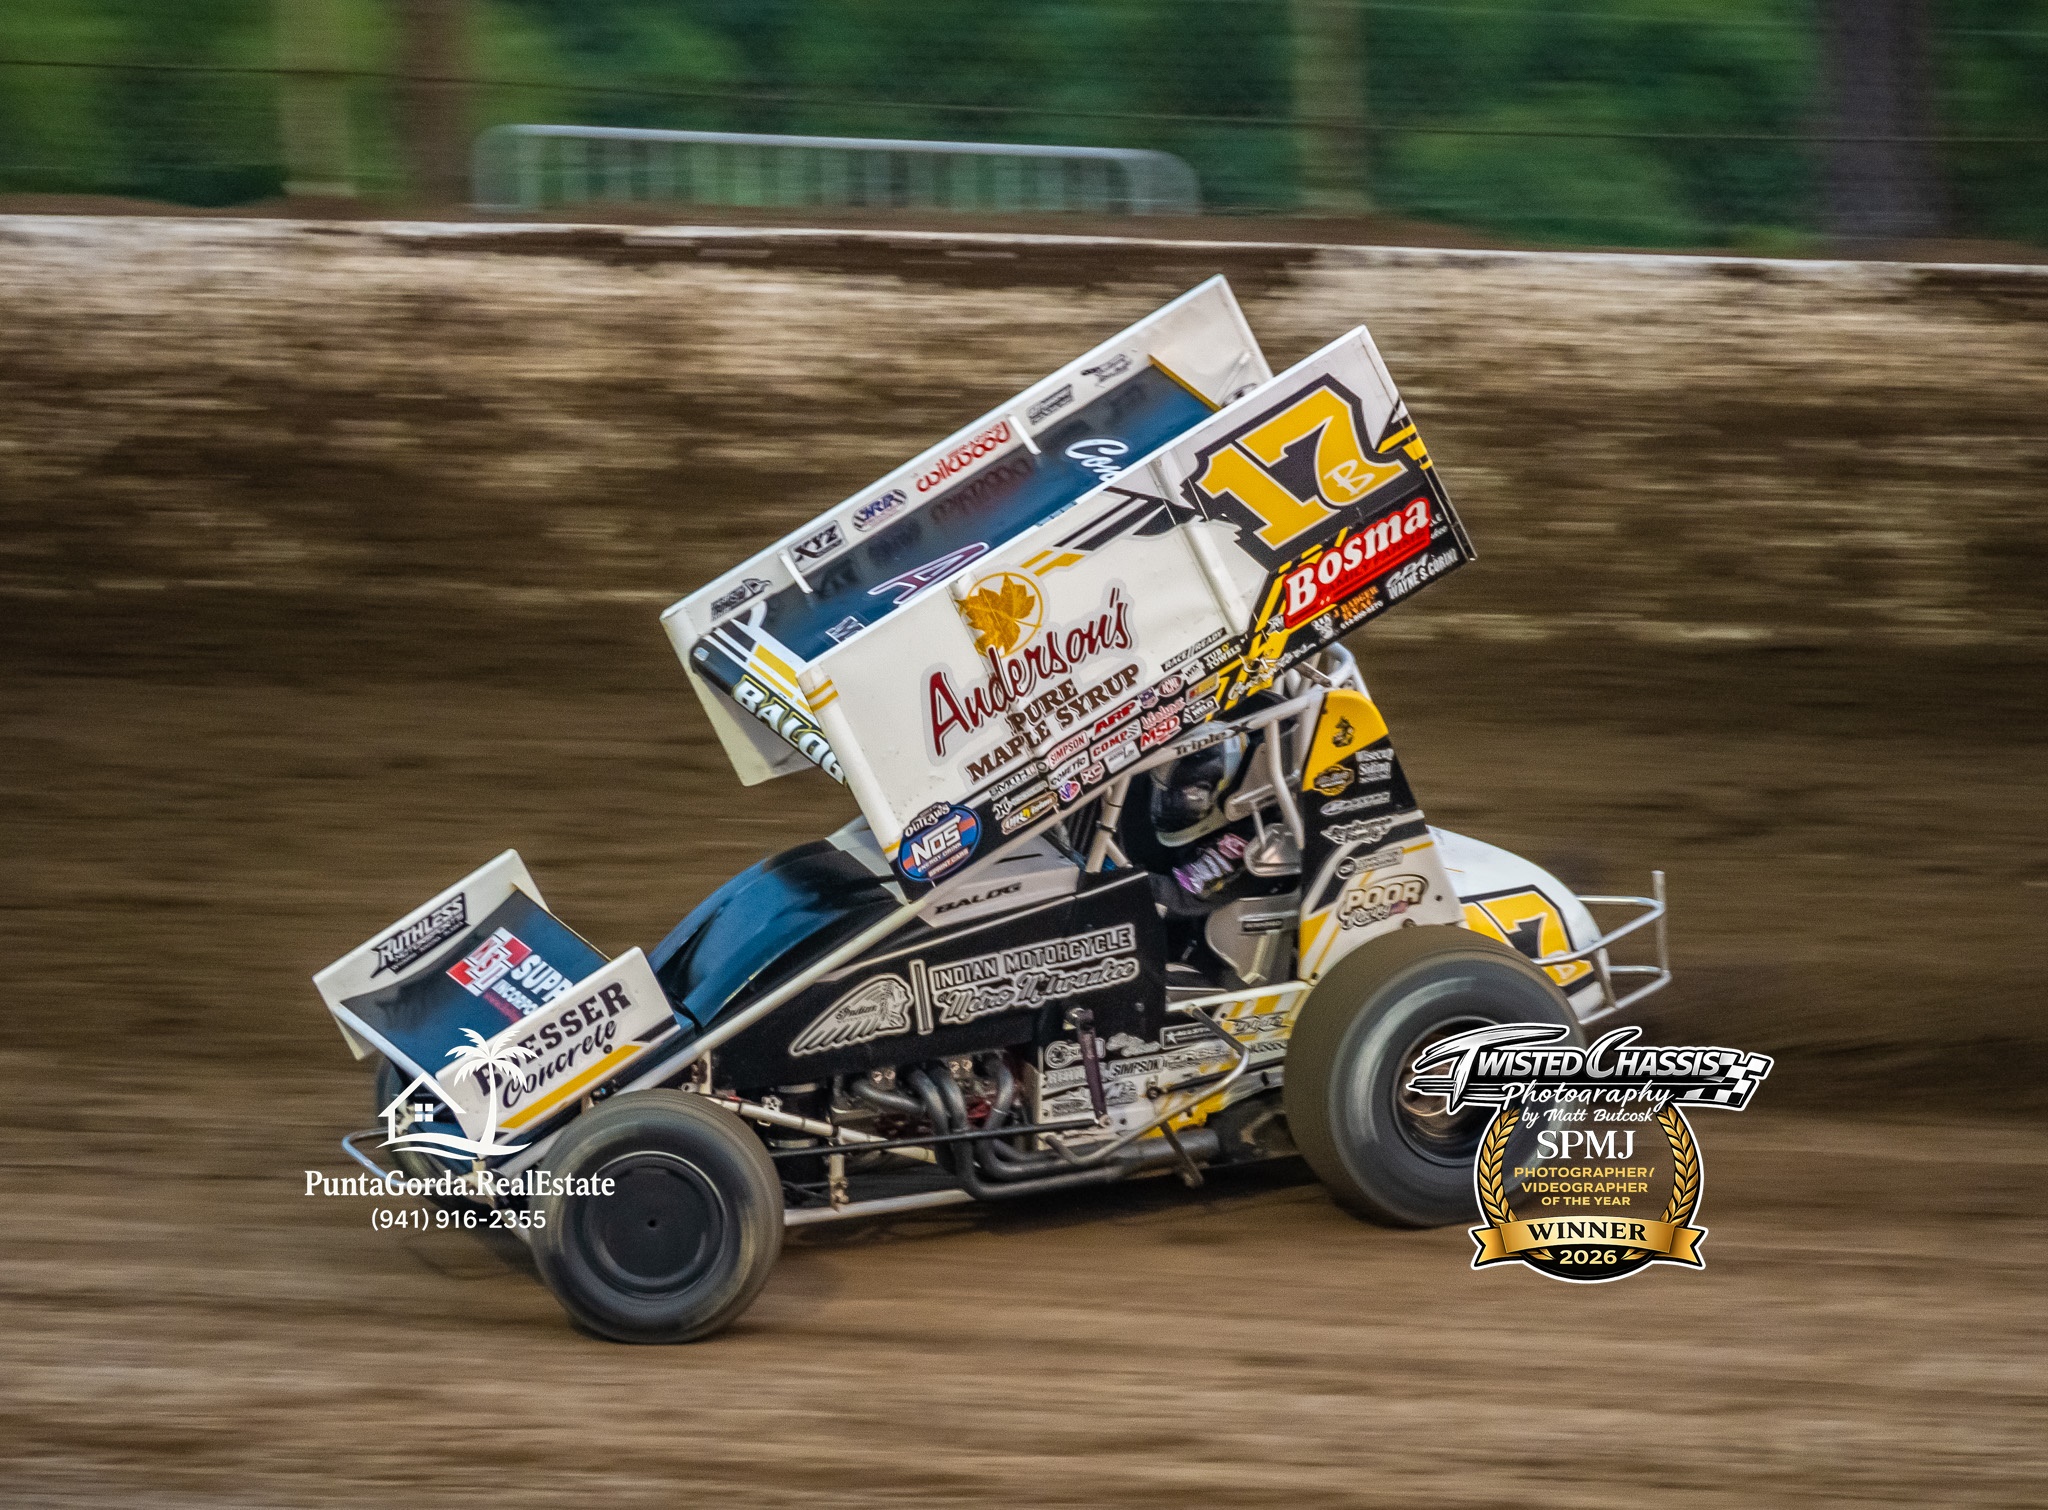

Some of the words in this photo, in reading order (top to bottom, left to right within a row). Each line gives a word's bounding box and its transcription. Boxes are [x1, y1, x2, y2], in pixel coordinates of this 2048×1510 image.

[915, 421, 1011, 492] wilwood
[1196, 385, 1407, 550] 17
[1324, 459, 1375, 496] B
[1286, 501, 1429, 616] Bosma
[929, 588, 1132, 756] Anderson's
[733, 675, 845, 785] BALOG
[966, 721, 1052, 783] MAPLE
[1056, 664, 1140, 729] SYRUP
[1006, 679, 1080, 736] PURE
[1095, 702, 1135, 734] ARP
[1141, 716, 1179, 747] MSD
[1050, 735, 1085, 764] SIMPSON
[1093, 730, 1127, 757] COMP
[911, 814, 962, 867] NOS
[935, 882, 1021, 914] BALOG
[1345, 880, 1422, 911] POOR
[377, 896, 463, 966] RUTHLESS
[935, 957, 998, 990] INDIAN
[1004, 930, 1131, 974] MOTORCYCLE
[1017, 960, 1135, 1003] Mlwaukee
[502, 1019, 617, 1109] Concrete
